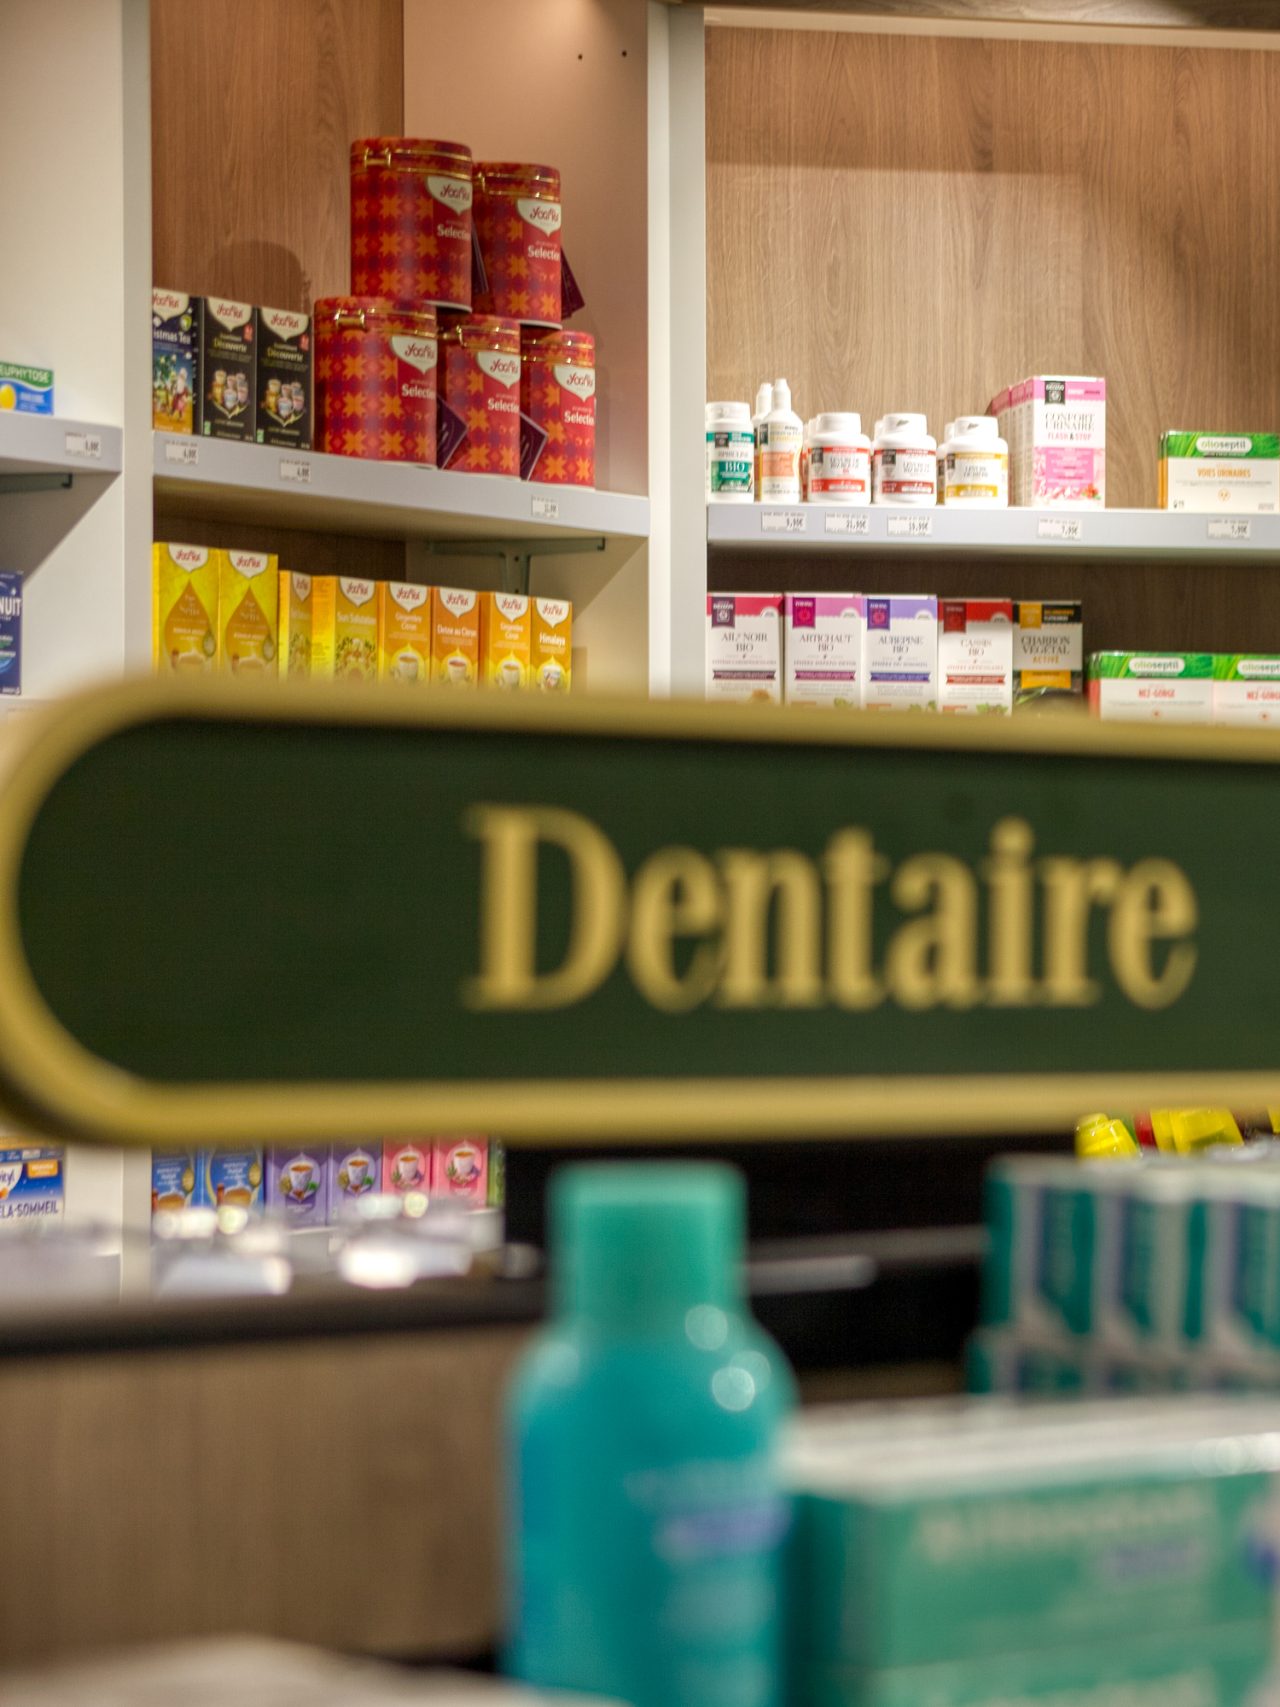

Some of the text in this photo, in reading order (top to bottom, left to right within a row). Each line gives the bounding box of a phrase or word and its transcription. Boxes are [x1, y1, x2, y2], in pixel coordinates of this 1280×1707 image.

[1200, 438, 1247, 452] olioseptil
[725, 462, 746, 474] BIO
[742, 632, 768, 643] NOIR
[799, 633, 853, 643] ARTICHAUT
[1020, 635, 1071, 647] CHARBON
[736, 643, 754, 652] BIO
[817, 642, 834, 652] BIO
[466, 805, 1198, 1012] Dentaire
